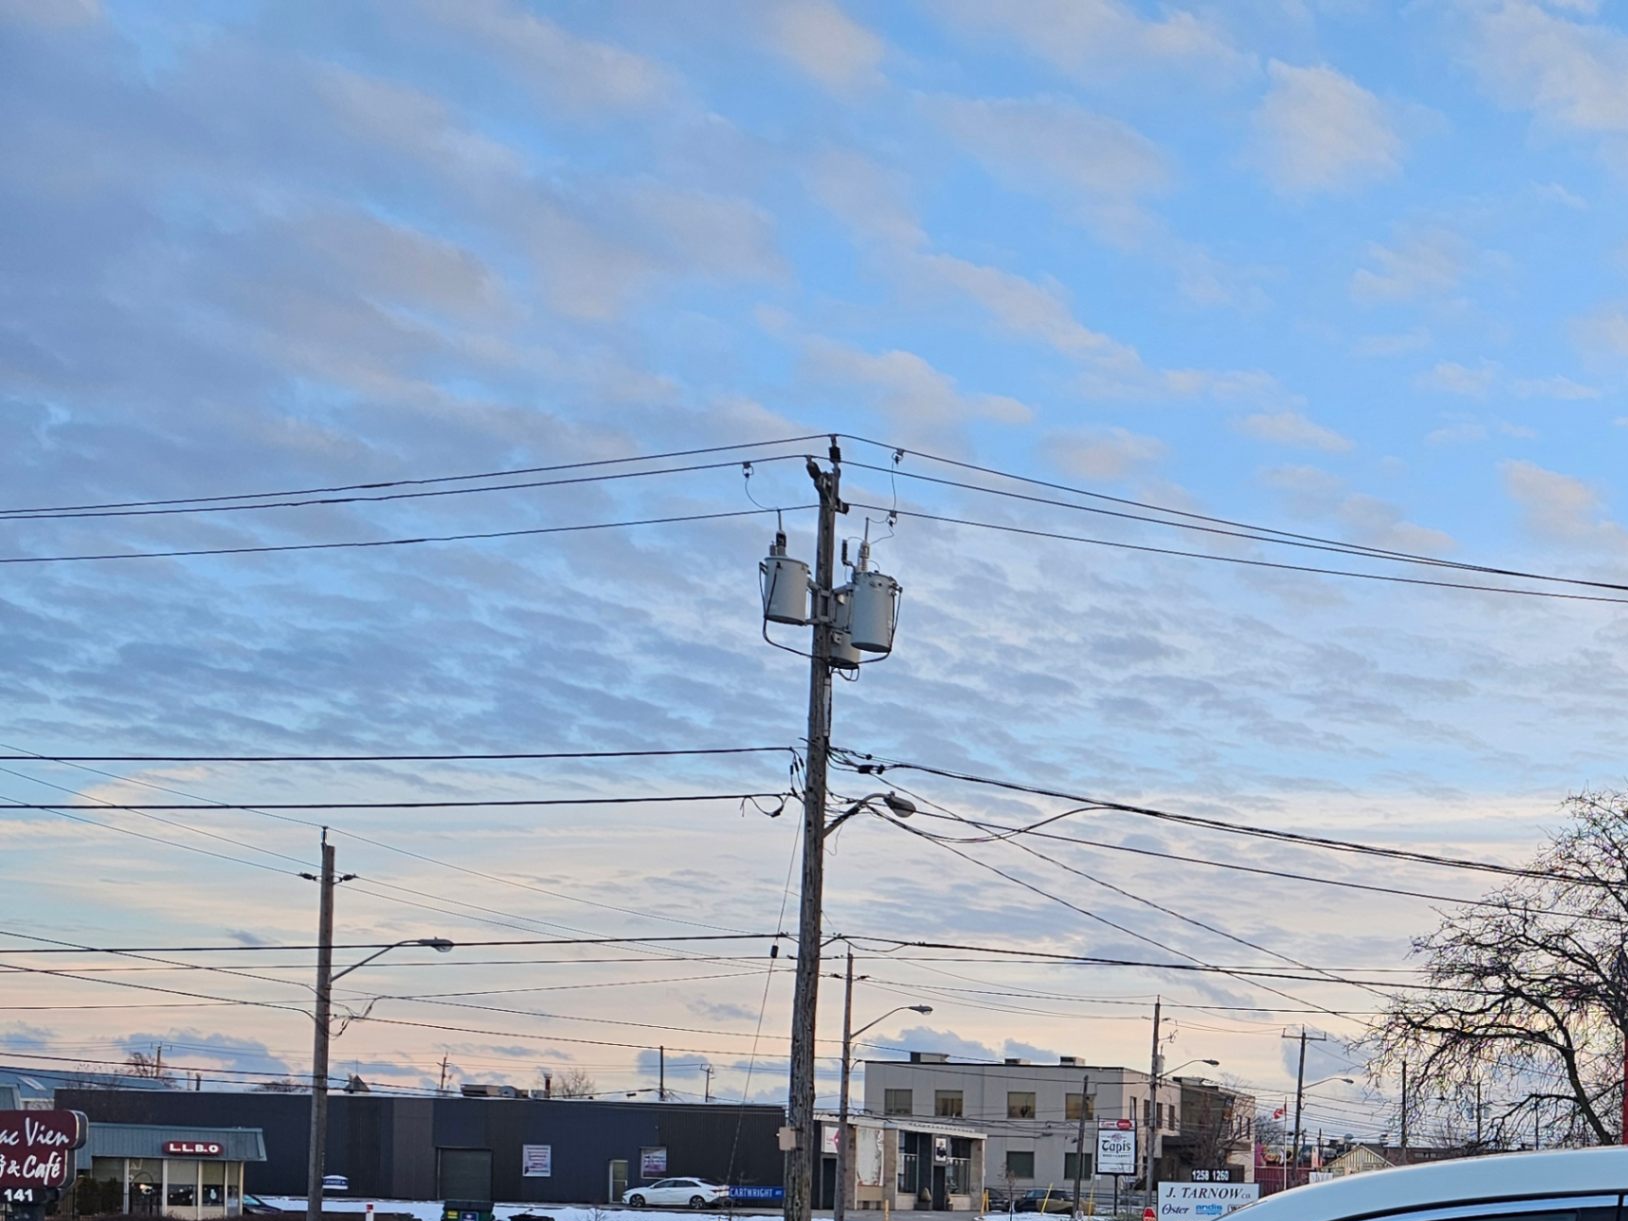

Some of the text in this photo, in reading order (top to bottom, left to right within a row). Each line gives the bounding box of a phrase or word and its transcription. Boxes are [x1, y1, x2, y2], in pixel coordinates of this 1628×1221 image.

[24, 1116, 70, 1147] Vien
[1102, 1140, 1131, 1153] Tapis
[22, 1151, 62, 1186] Café
[1192, 1170, 1209, 1181] 1258
[3, 1188, 33, 1202] 141
[730, 1187, 773, 1197] CARTWRIGHT
[1165, 1187, 1177, 1199] J.
[1181, 1187, 1244, 1200] TARNOW
[1161, 1203, 1191, 1216] Oster
